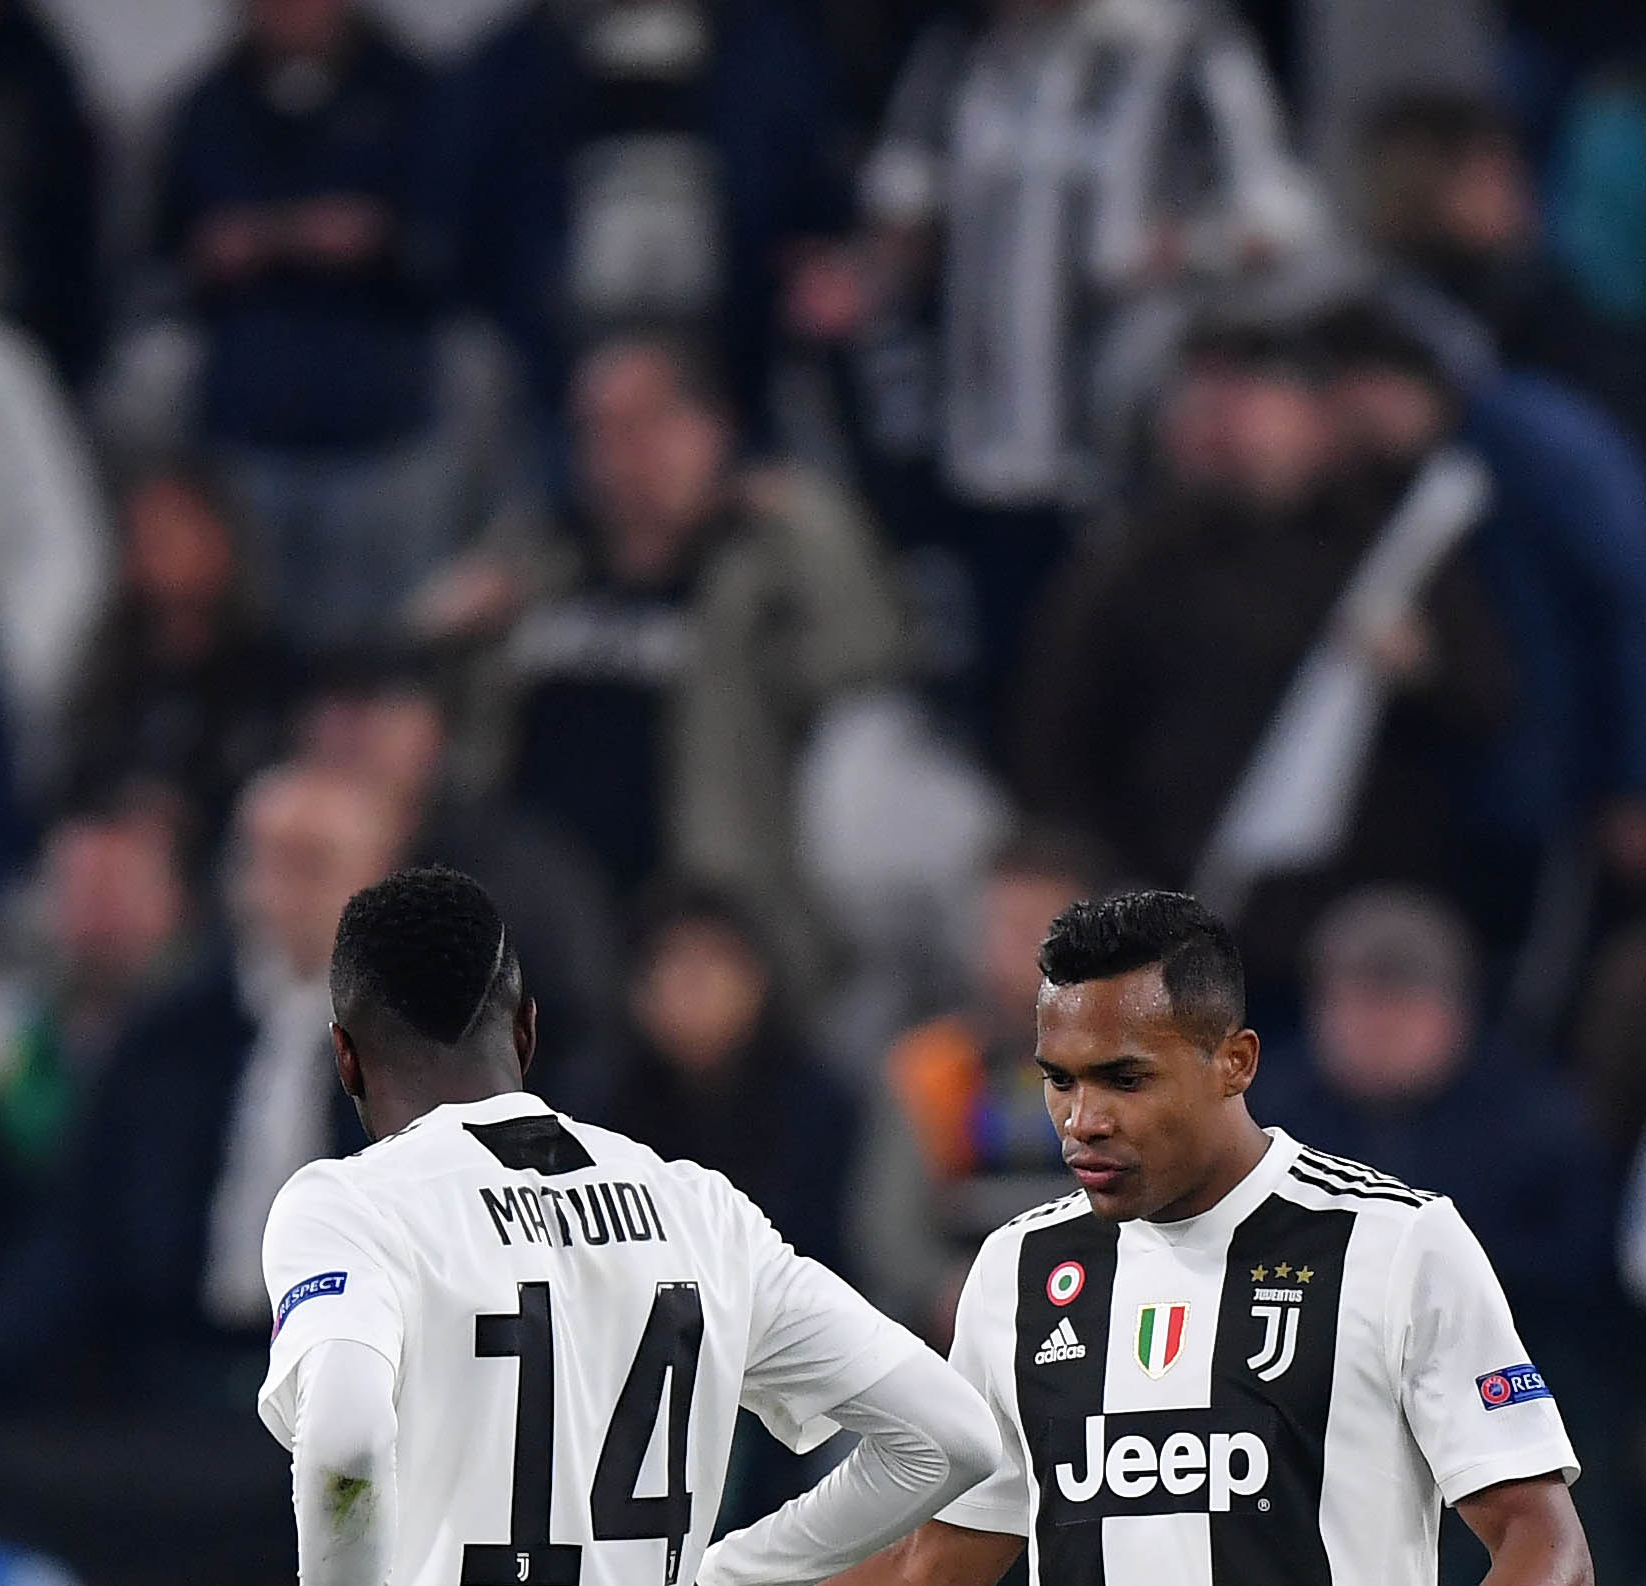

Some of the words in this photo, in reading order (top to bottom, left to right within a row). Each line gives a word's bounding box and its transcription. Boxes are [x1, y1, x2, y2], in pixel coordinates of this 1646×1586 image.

[479, 1182, 667, 1248] MATUIDI
[279, 1276, 345, 1319] RESPECT
[1034, 1341, 1086, 1365] adidas
[1055, 1415, 1269, 1512] Jeep
